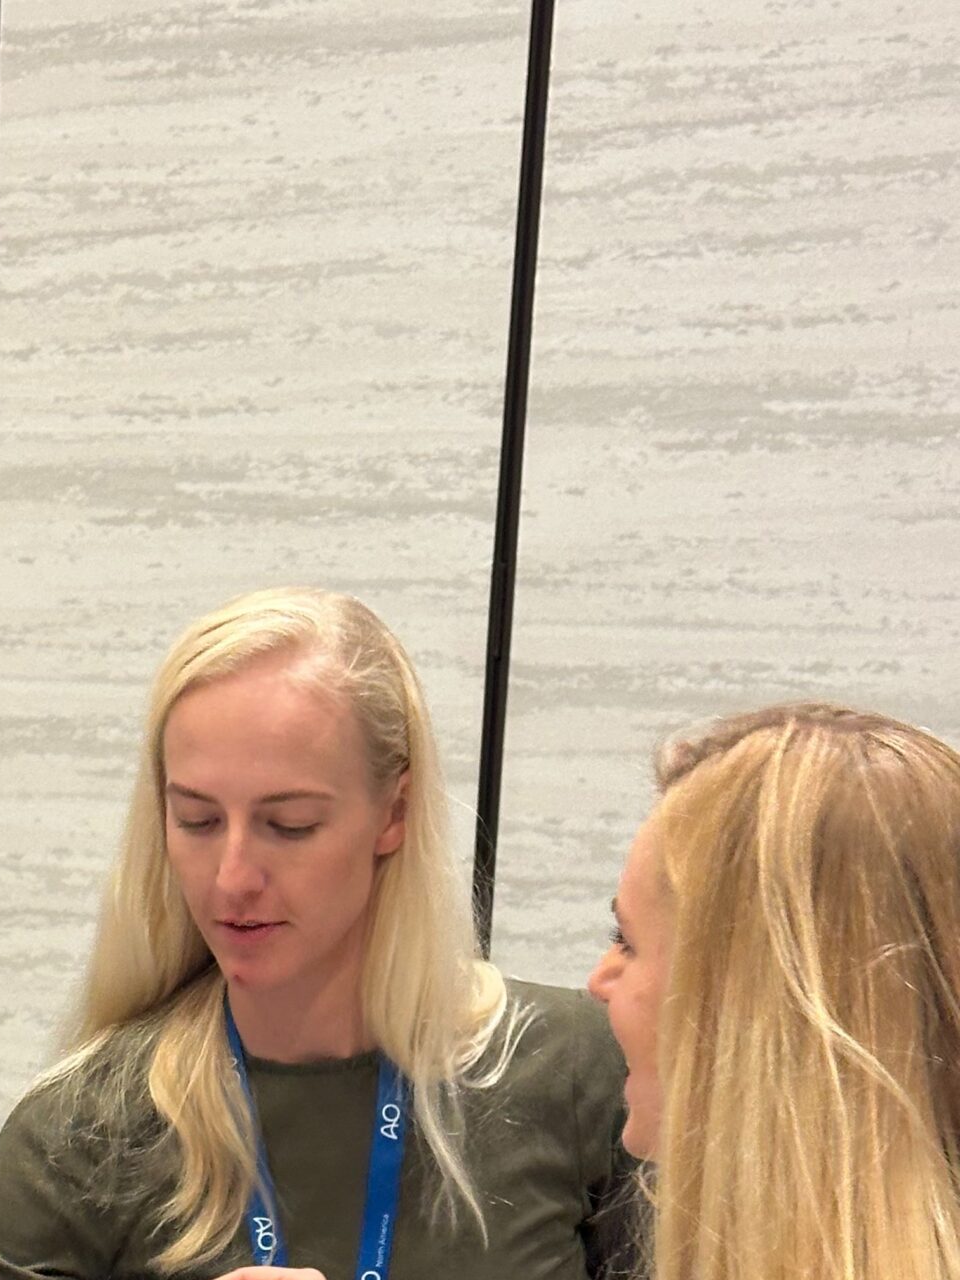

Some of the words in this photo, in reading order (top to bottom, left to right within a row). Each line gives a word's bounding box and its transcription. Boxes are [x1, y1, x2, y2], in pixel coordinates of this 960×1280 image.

[380, 1103, 401, 1140] AO
[252, 1216, 278, 1251] AO
[378, 1213, 389, 1243] America
[375, 1243, 386, 1268] North
